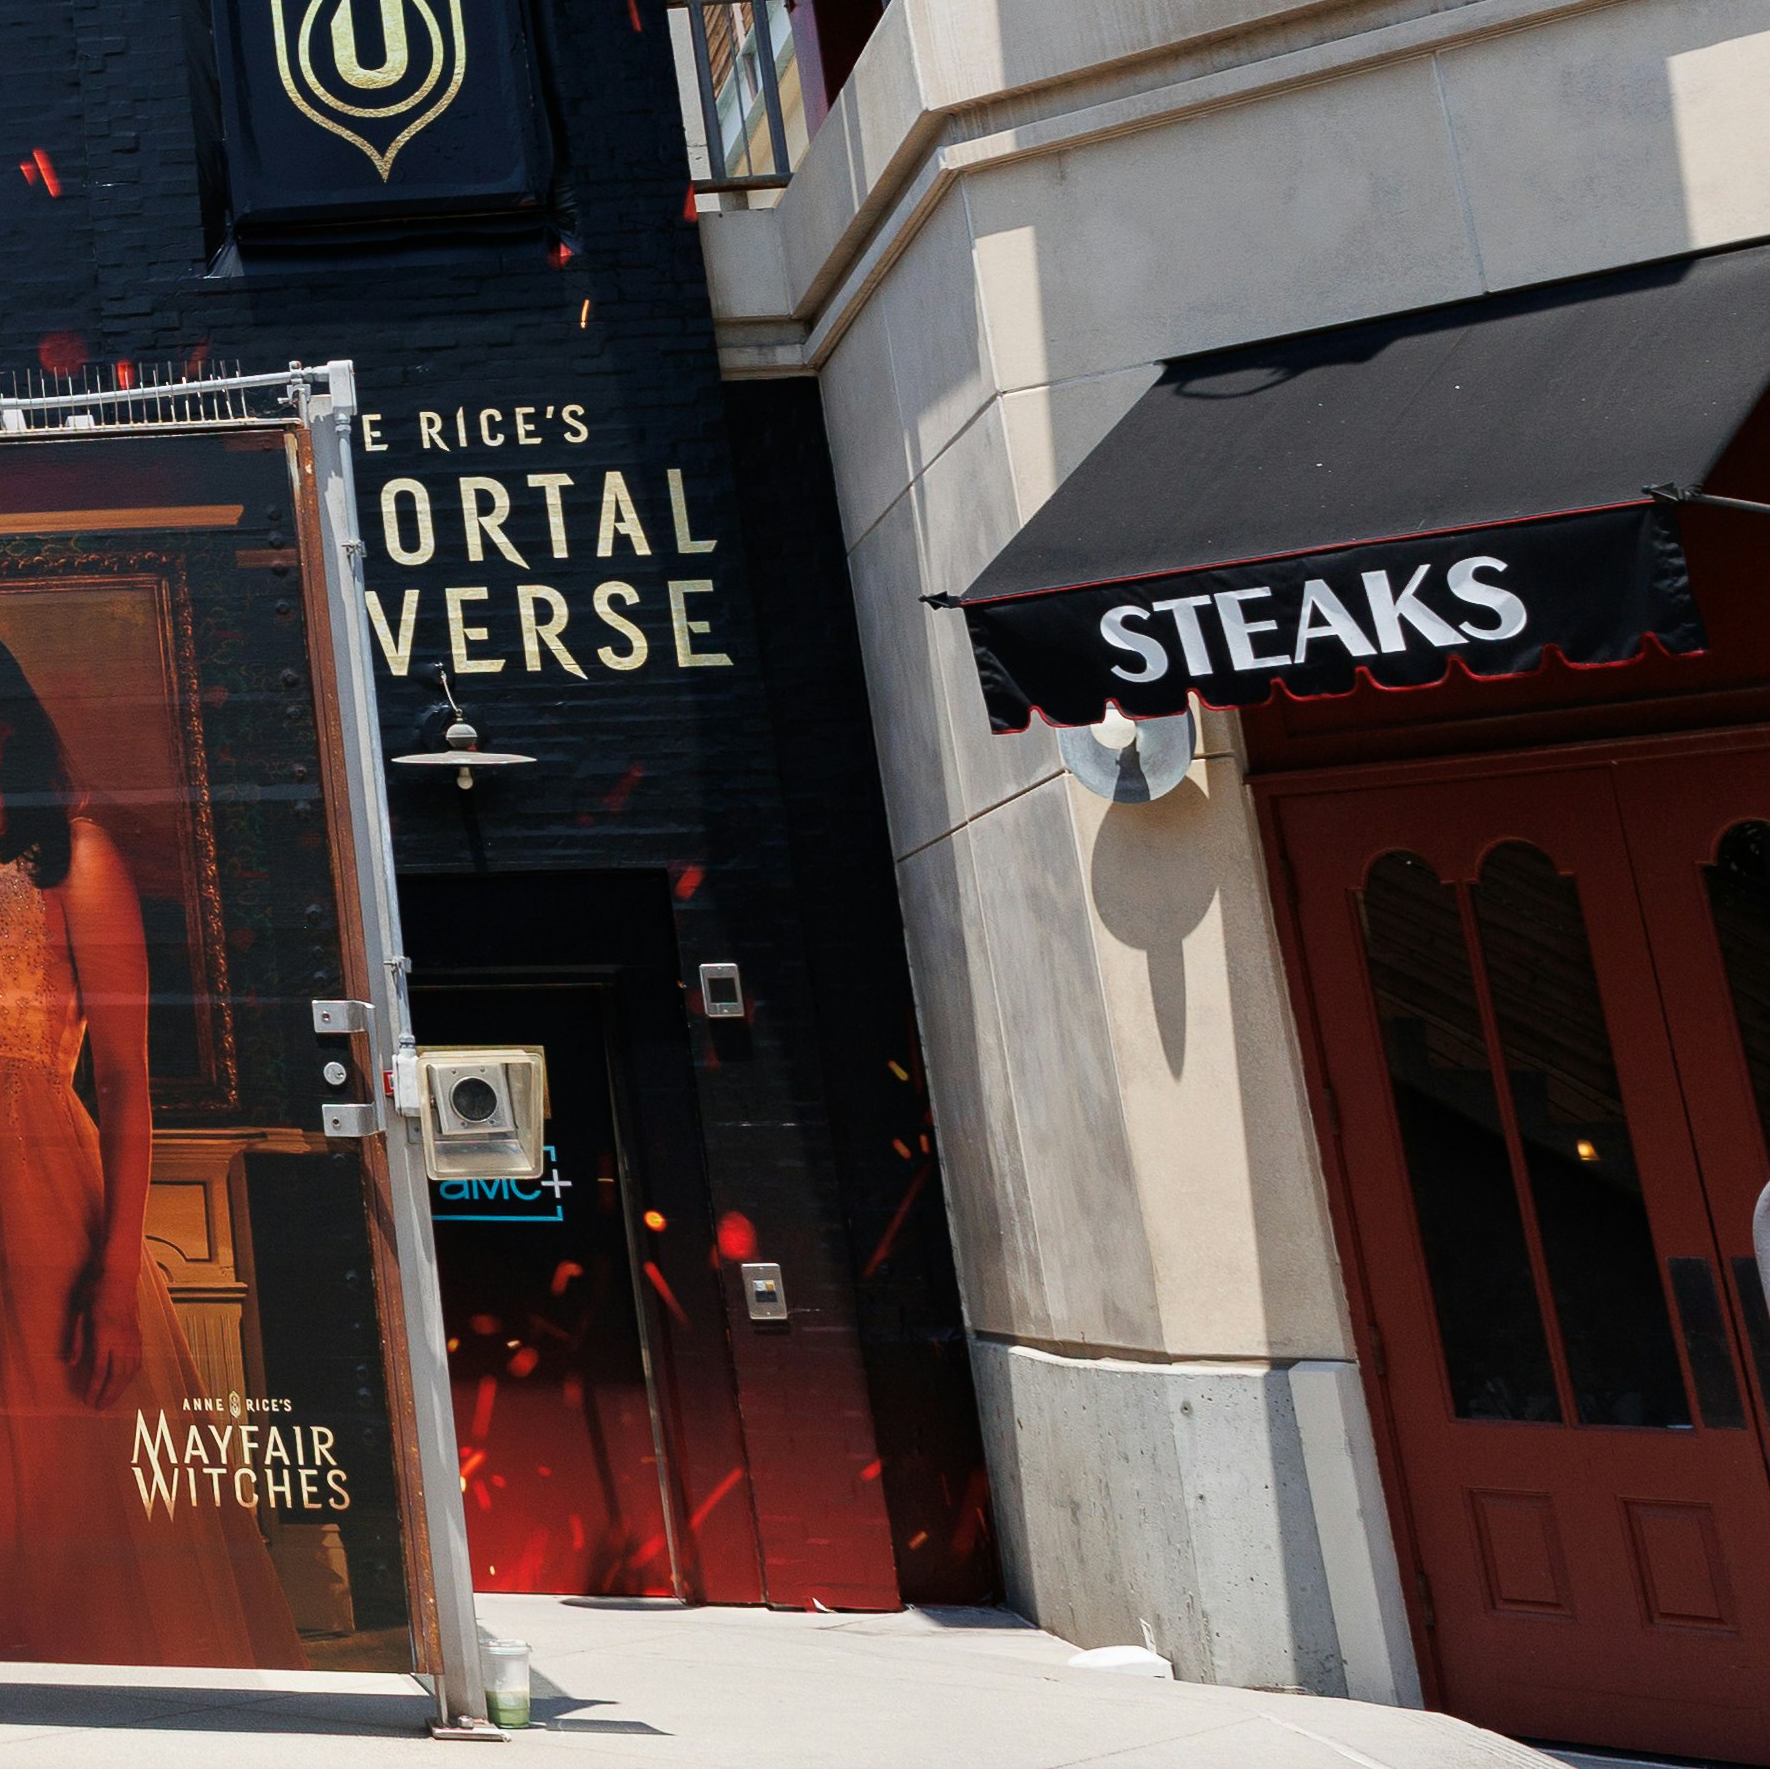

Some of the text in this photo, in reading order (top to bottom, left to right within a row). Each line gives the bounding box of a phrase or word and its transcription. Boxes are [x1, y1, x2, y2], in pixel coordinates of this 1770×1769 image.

[418, 403, 589, 452] RICE'S
[1100, 555, 1528, 684] STEAKS
[182, 1398, 293, 1412] ANNE RICE'S
[130, 1408, 338, 1466] MAYFAIR
[130, 1466, 351, 1523] WITCHES
